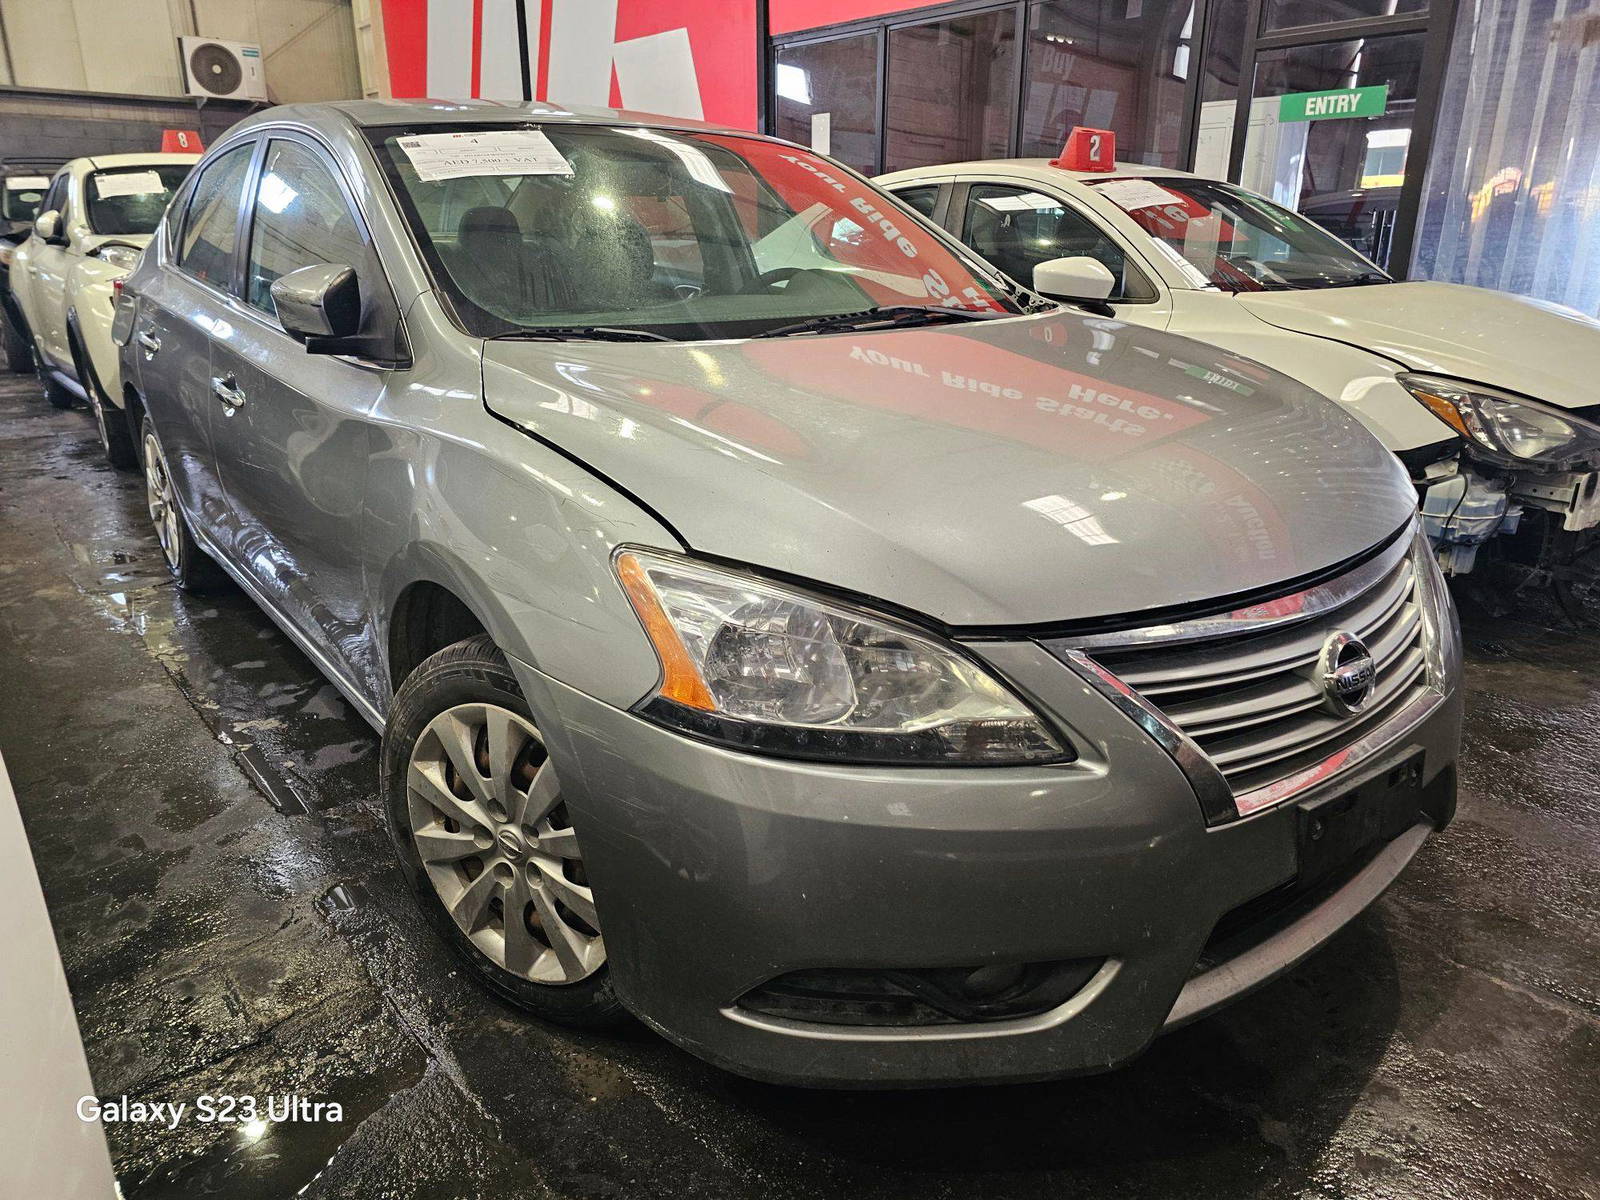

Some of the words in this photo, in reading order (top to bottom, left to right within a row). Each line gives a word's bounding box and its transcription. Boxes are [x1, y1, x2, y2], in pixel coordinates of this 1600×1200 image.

[1305, 93, 1362, 116] ENTRY
[178, 132, 188, 148] 8
[1089, 134, 1101, 162] 2
[1337, 665, 1376, 688] NISSAN
